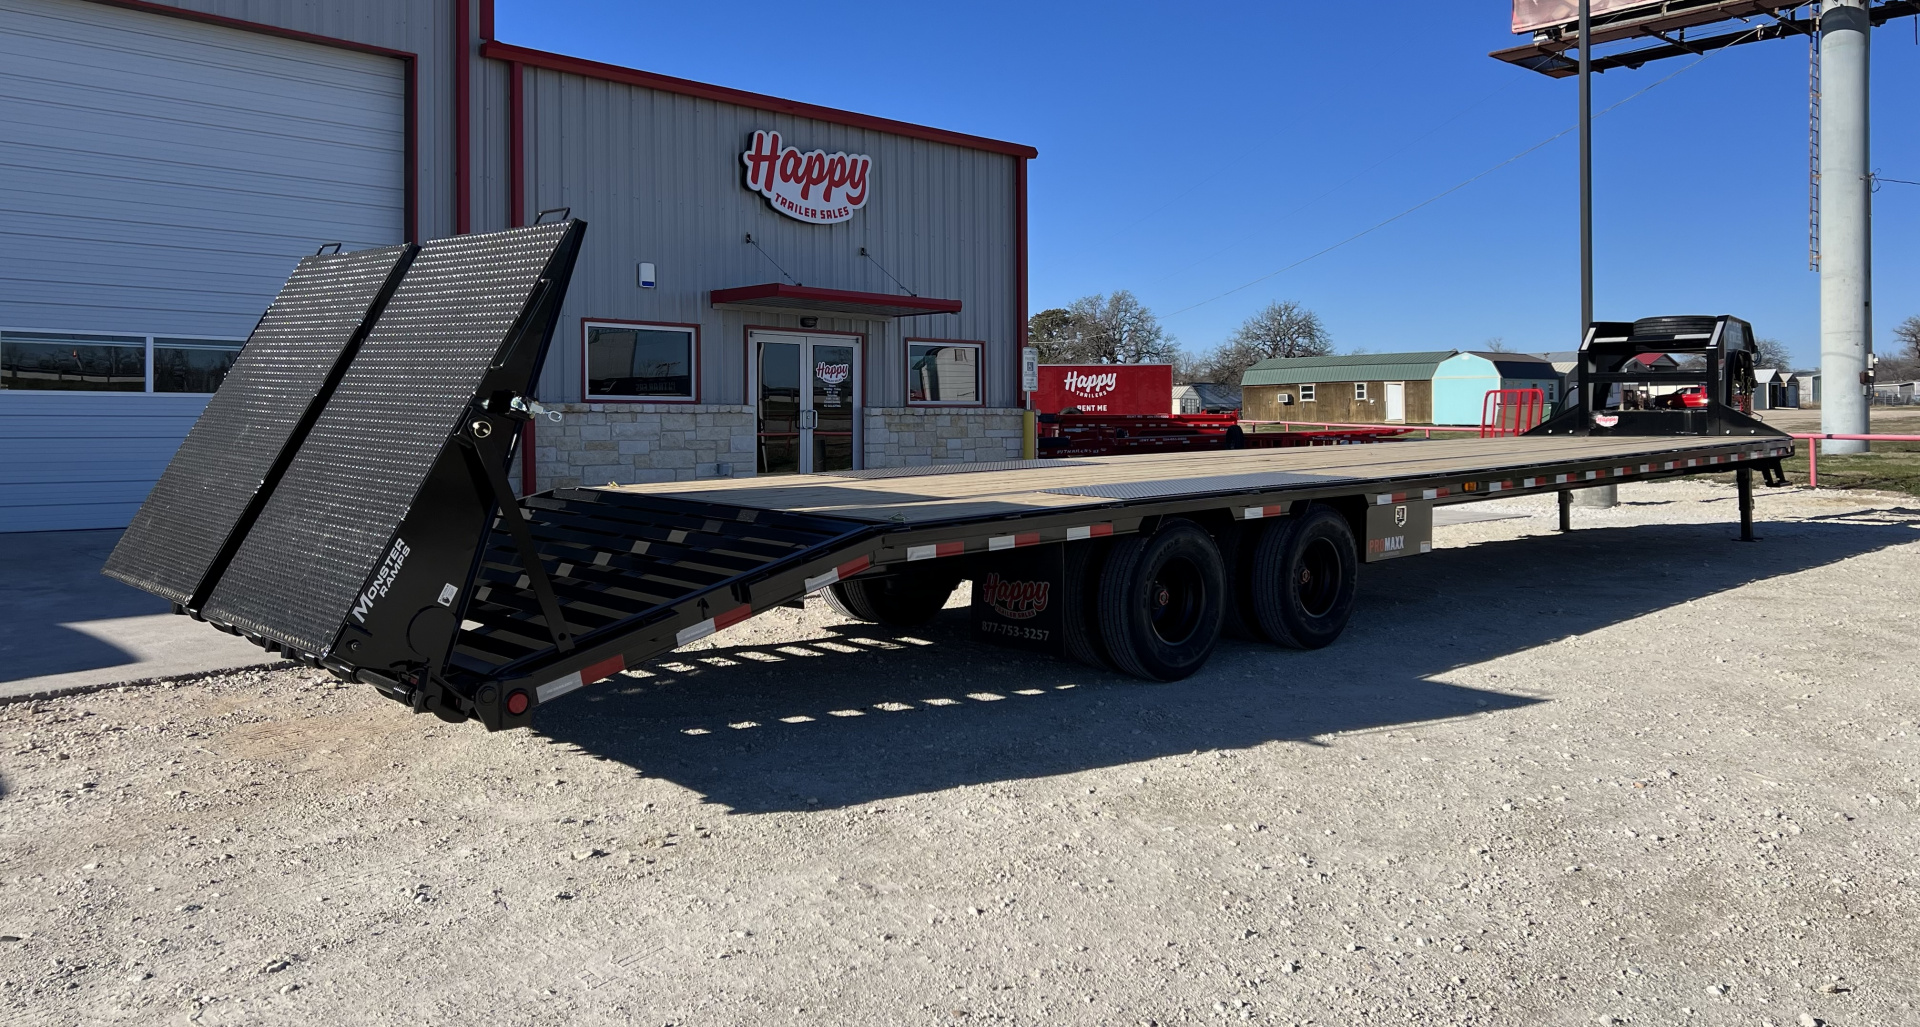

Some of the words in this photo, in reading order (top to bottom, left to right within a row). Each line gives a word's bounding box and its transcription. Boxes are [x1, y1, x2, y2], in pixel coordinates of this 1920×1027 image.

[747, 132, 869, 206] Happy
[775, 192, 817, 219] TRAILER
[819, 206, 849, 220] SALES
[816, 362, 848, 378] Happy
[1064, 370, 1117, 392] Happy
[1076, 390, 1107, 398] TRAILERS
[1076, 404, 1096, 412] RENT
[1097, 404, 1108, 412] ME
[1369, 535, 1404, 553] PROMAXX
[351, 538, 406, 624] MONSTER
[379, 545, 411, 598] RAMPS
[983, 573, 1050, 611] Happy
[982, 621, 1050, 641] 877-753-3257
